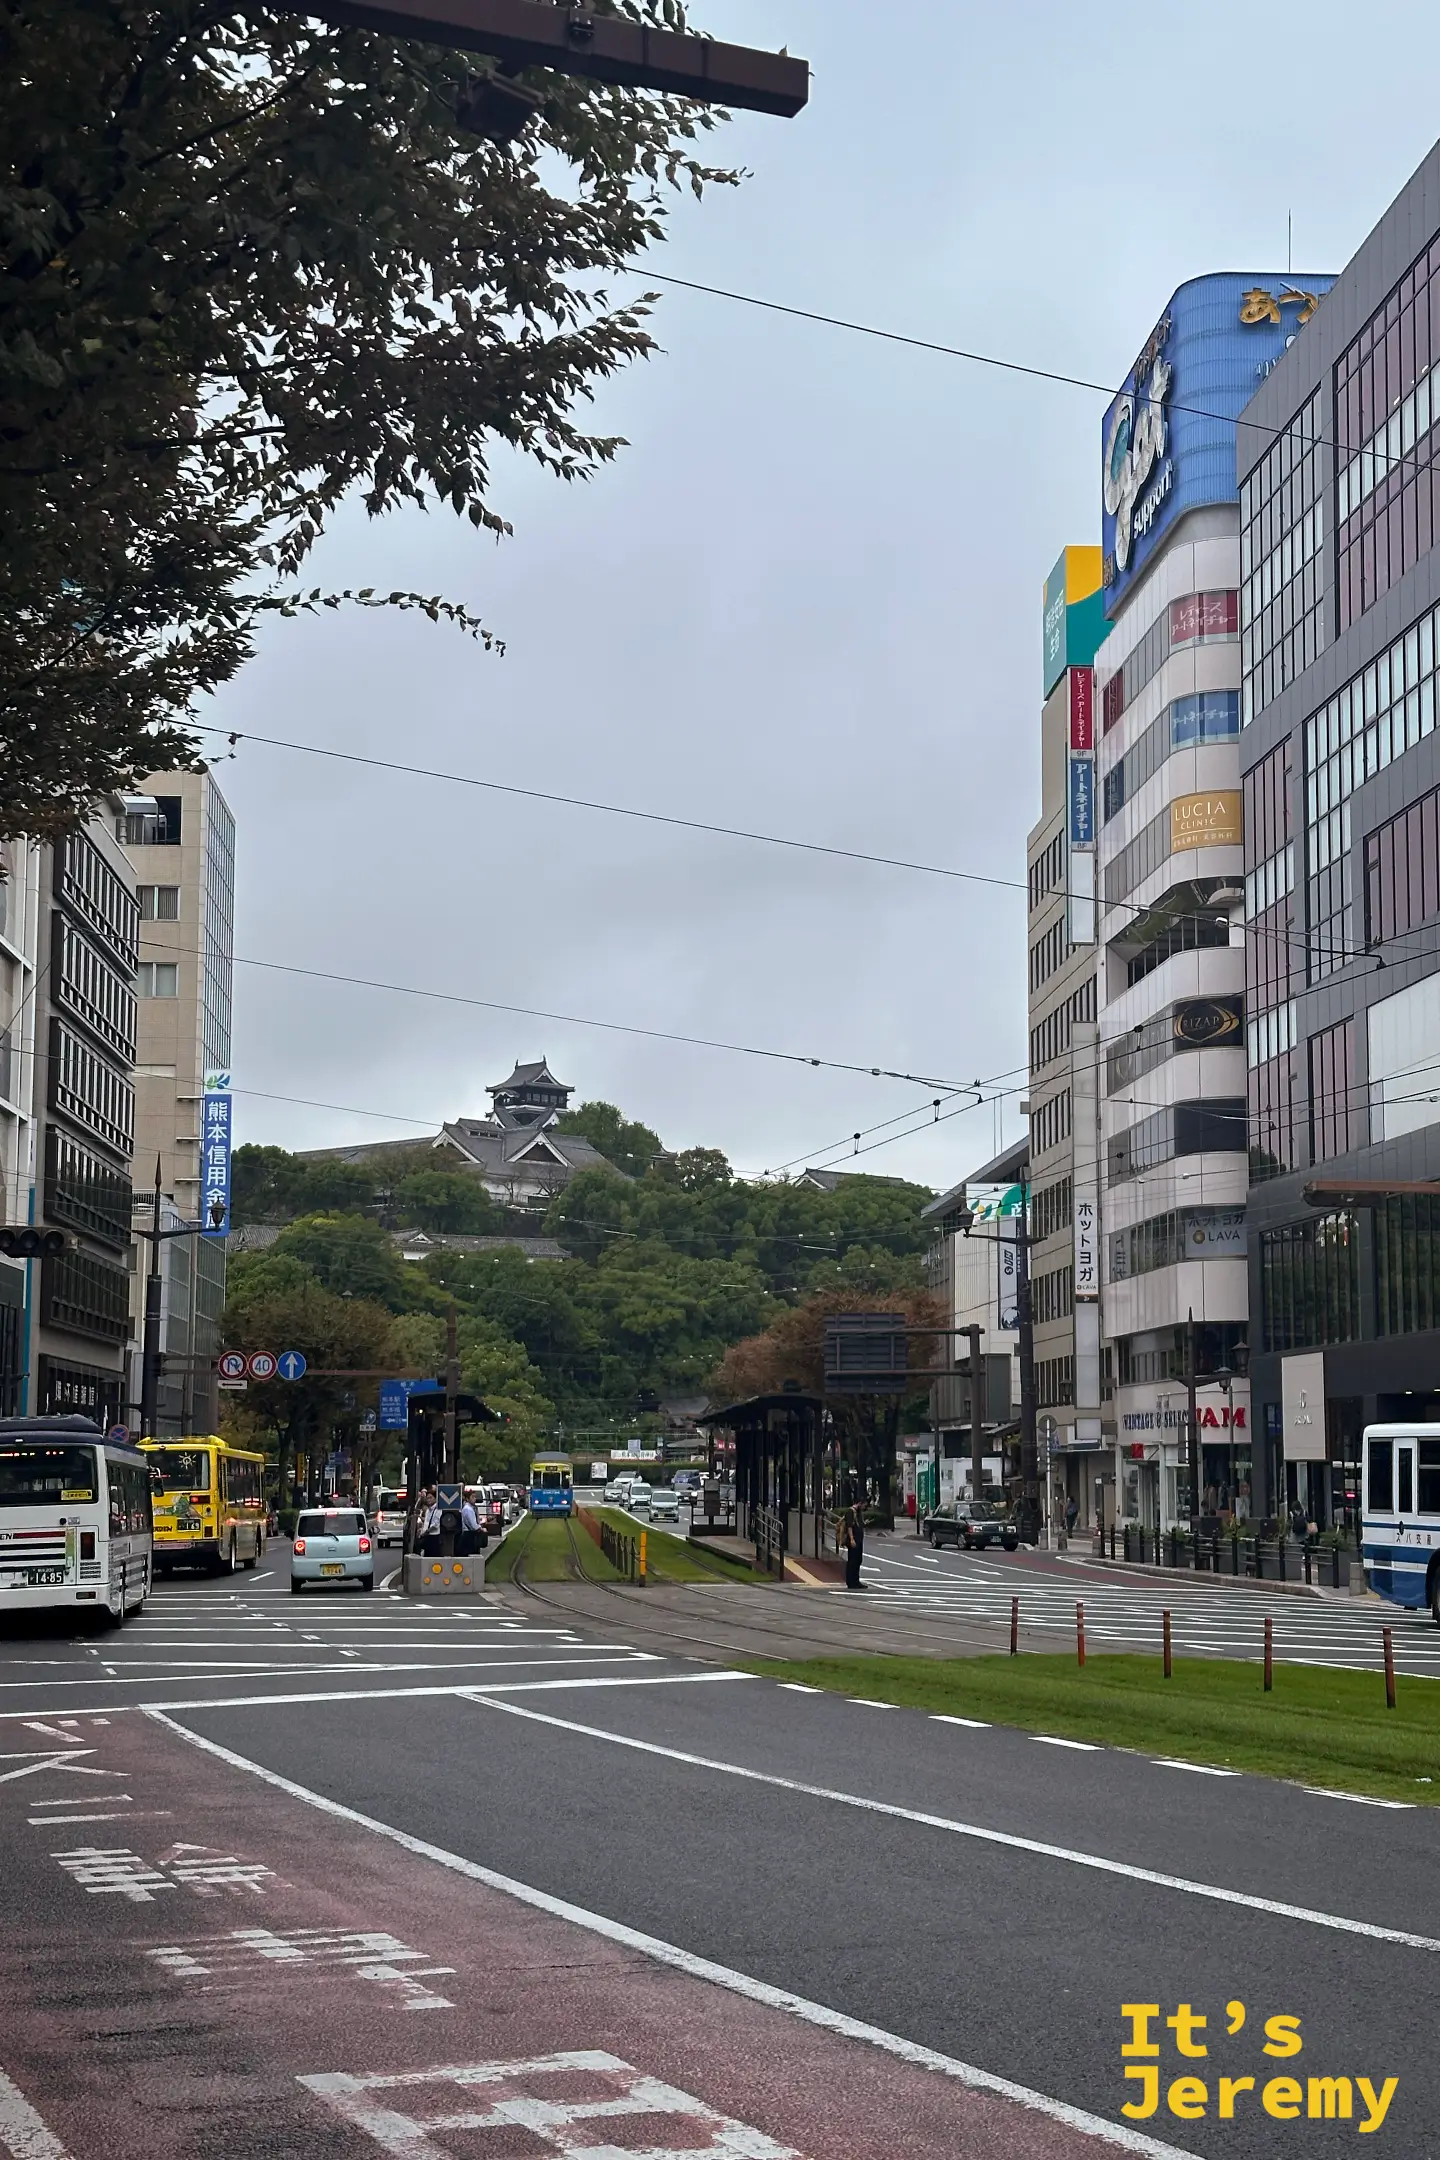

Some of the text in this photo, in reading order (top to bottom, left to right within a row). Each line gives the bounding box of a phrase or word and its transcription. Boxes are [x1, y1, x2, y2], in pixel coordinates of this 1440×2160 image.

[1240, 283, 1322, 324] あつ
[1133, 459, 1174, 540] support
[1075, 763, 1089, 839] アートネイチャー
[1175, 800, 1226, 821] LUCIA
[1180, 818, 1217, 830] CLINIC
[1183, 1015, 1220, 1027] RIZAP
[1188, 1212, 1245, 1228] ホットヨガ
[1078, 1203, 1094, 1282] ホットヨガ
[1208, 1230, 1241, 1242] LAVA
[255, 1359, 270, 1372] 40
[1123, 1411, 1154, 1430] VINTAGE
